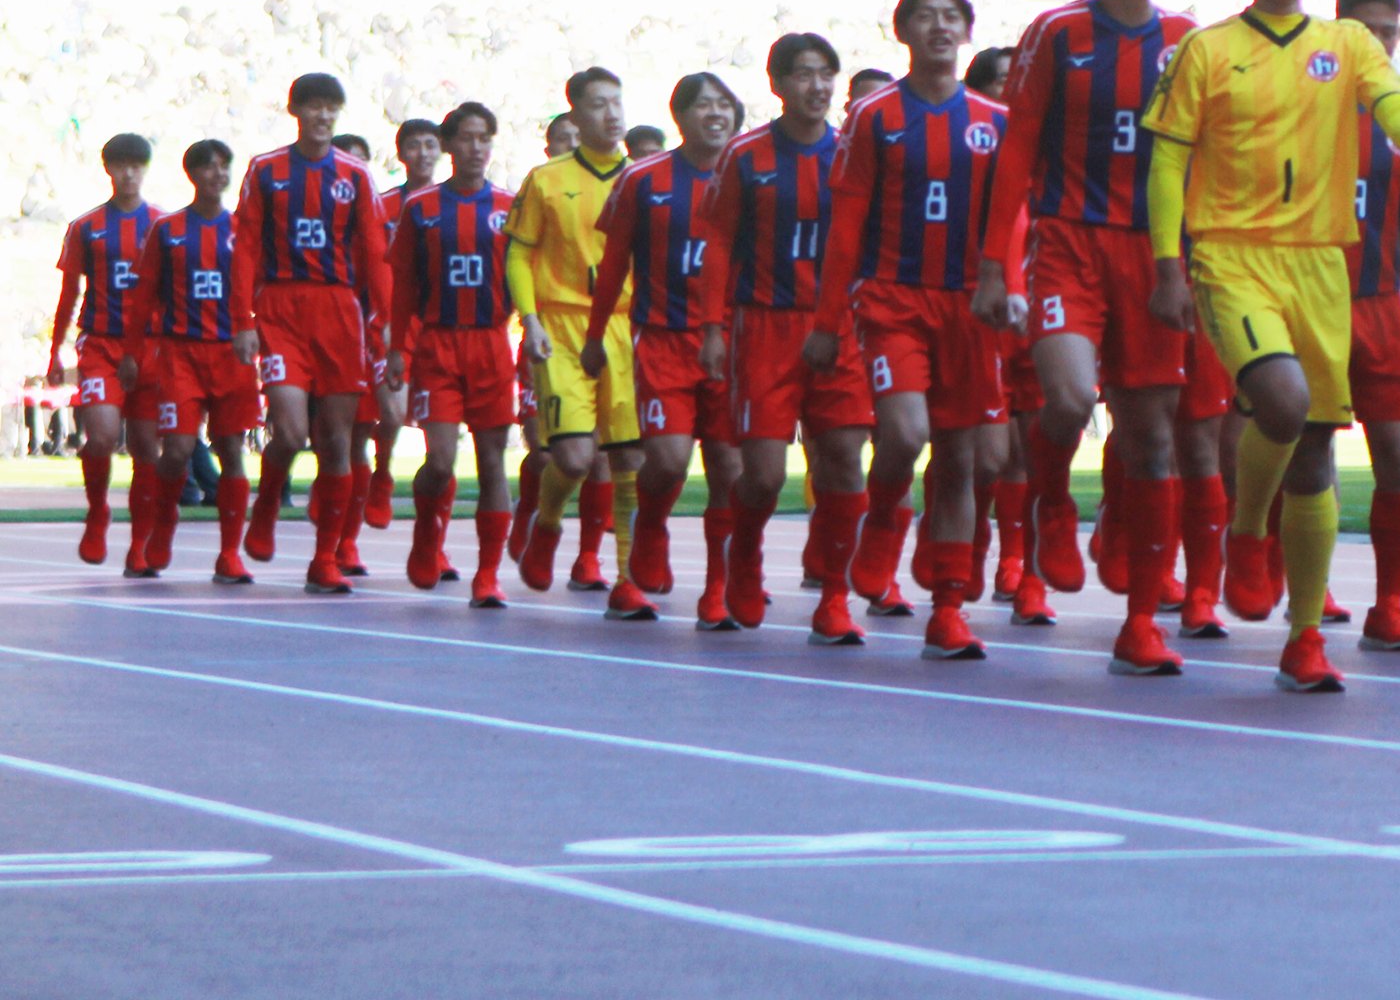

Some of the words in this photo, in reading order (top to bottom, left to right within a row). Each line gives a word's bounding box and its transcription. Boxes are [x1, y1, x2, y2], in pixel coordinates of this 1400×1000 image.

[1112, 110, 1136, 153] 3
[1282, 158, 1293, 204] 1
[925, 180, 948, 222] 8
[297, 218, 326, 249] 23
[449, 254, 484, 287] 20
[1042, 295, 1065, 330] 3
[1241, 314, 1260, 352] 1
[81, 376, 106, 403] 29
[872, 355, 892, 393] 8
